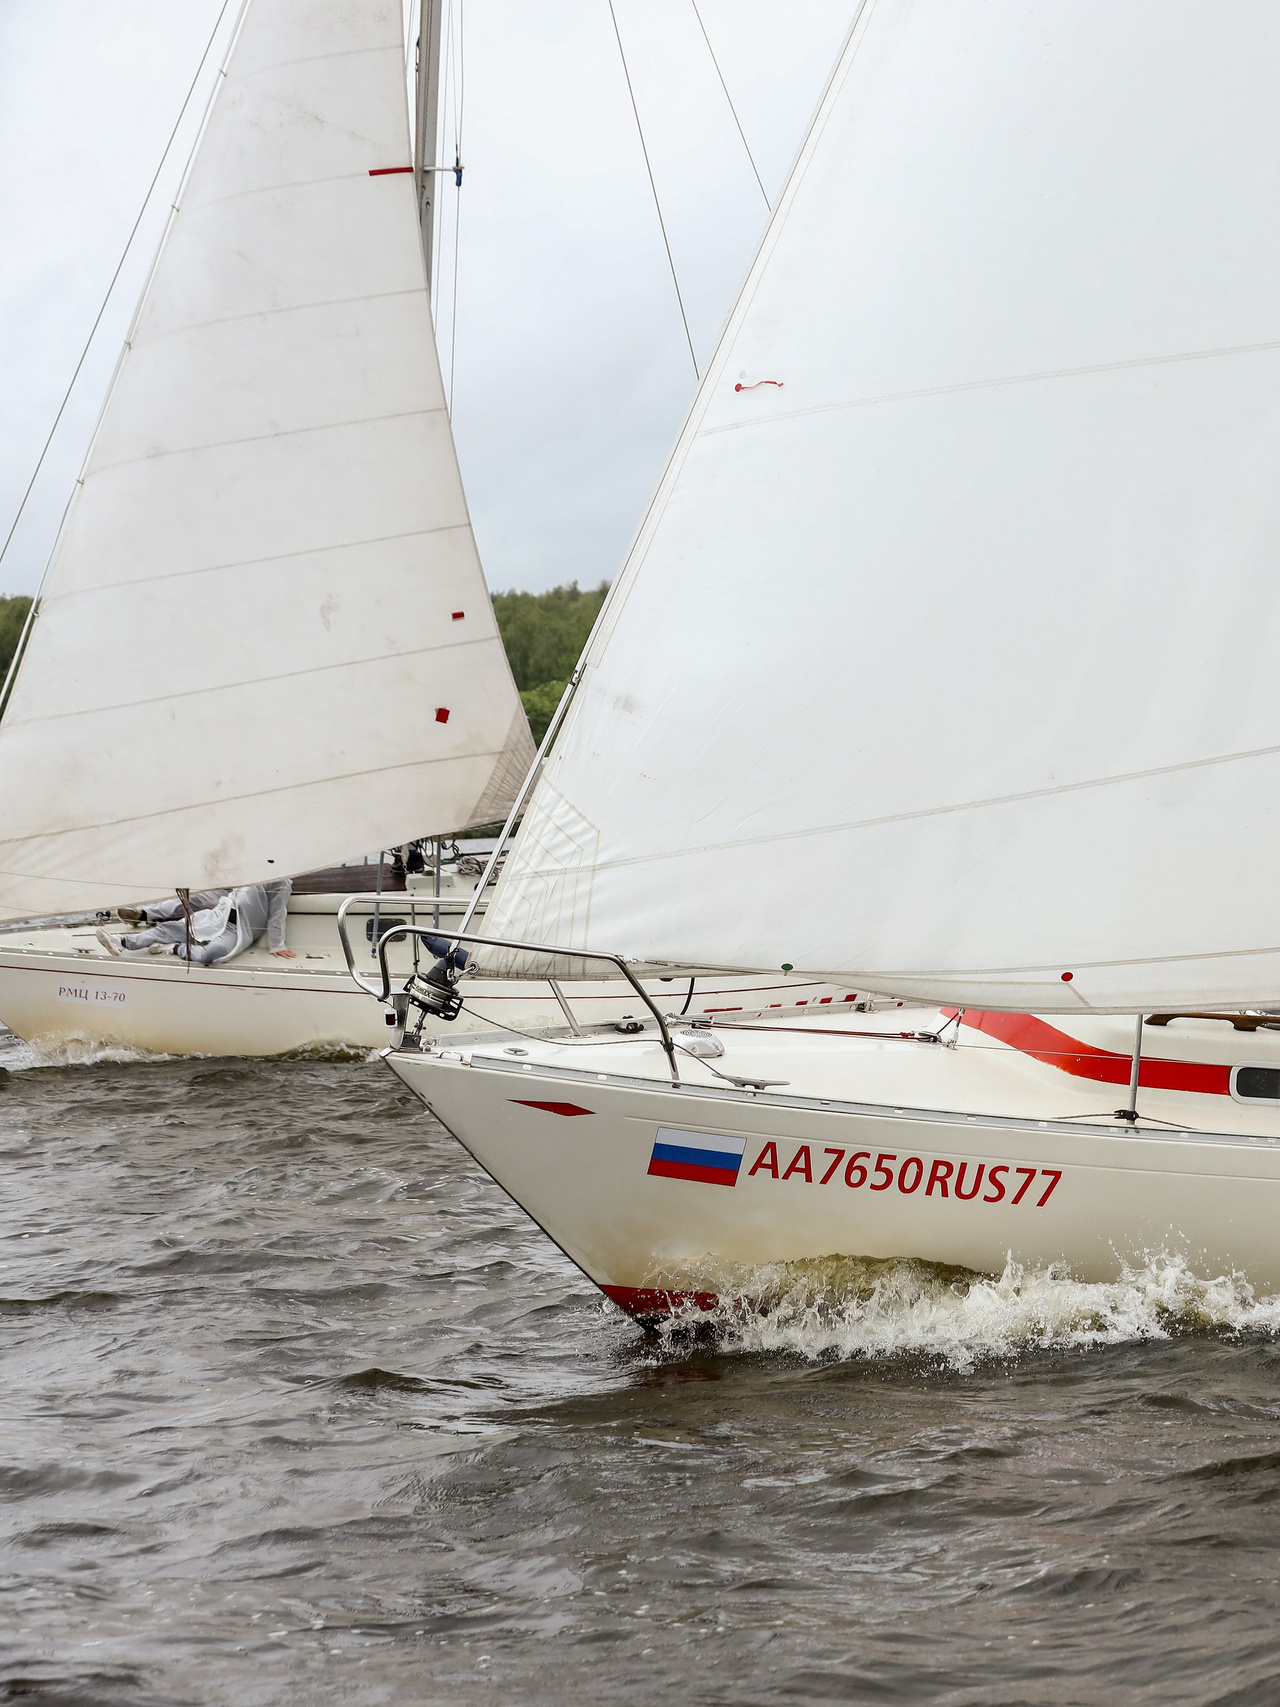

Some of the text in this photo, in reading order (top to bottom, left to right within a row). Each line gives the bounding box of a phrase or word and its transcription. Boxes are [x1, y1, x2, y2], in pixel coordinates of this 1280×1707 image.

[58, 986, 127, 1003] РМЦ 13-70
[748, 1141, 1063, 1208] AA7650RUS77
